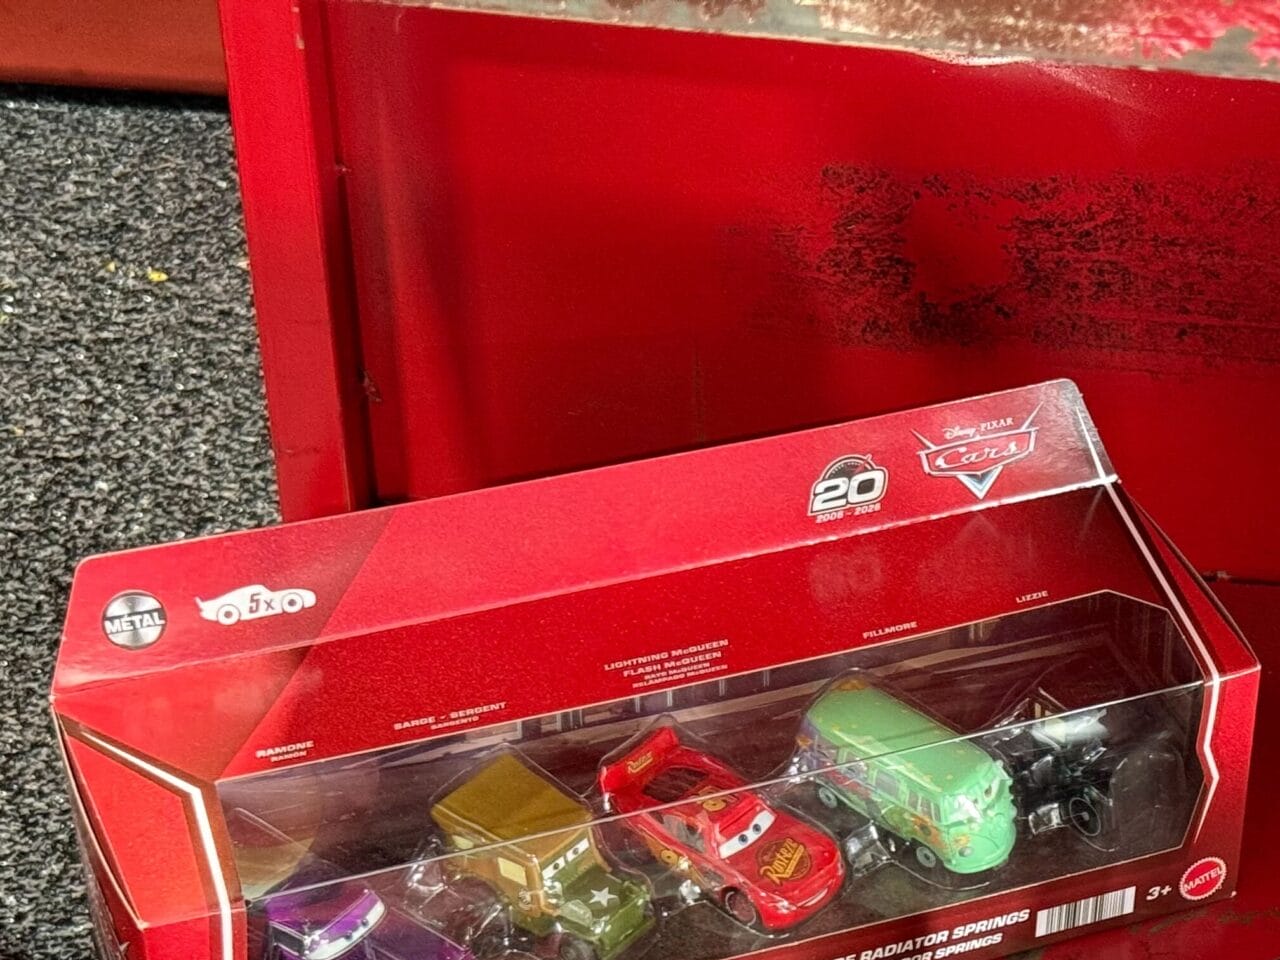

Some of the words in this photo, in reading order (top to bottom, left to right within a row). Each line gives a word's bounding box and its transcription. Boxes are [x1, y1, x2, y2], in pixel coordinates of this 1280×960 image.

[981, 417, 1013, 431] PIXAR
[935, 441, 1018, 469] Cars
[811, 469, 886, 512] 20
[816, 510, 845, 523] 2006
[853, 501, 881, 516] 2026
[1015, 590, 1049, 603] LIZZIE
[862, 621, 918, 640] FILLMORE
[603, 651, 669, 671] LIGHTNING
[671, 639, 729, 657] McQUEEN
[623, 663, 661, 678] FLASH
[664, 650, 722, 669] McQUEEN
[393, 716, 436, 730] SARGE
[450, 701, 508, 719] SERGENT
[430, 715, 480, 730] SARGENTO
[256, 740, 315, 759] RAMONE
[1183, 865, 1222, 892] MATTEL
[1146, 885, 1172, 901] 3+
[951, 908, 1030, 940] SPRINGS
[933, 932, 1003, 960] SPRINGS
